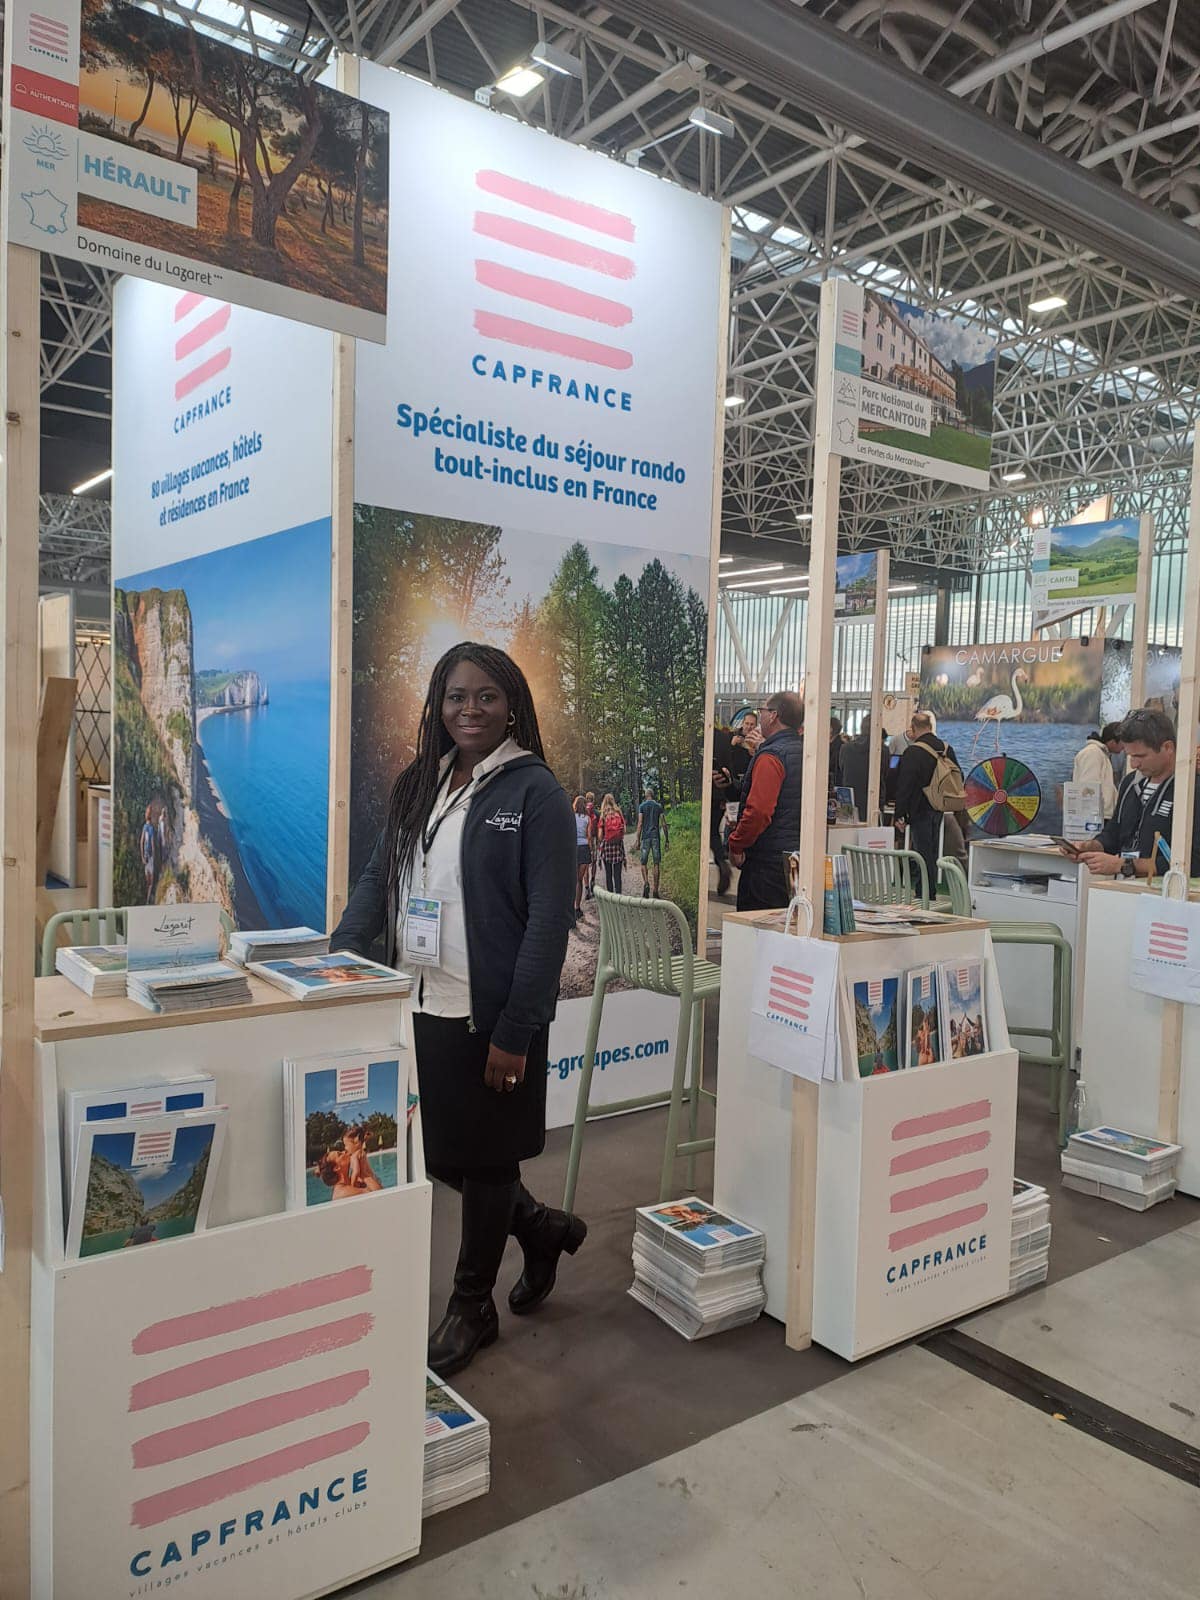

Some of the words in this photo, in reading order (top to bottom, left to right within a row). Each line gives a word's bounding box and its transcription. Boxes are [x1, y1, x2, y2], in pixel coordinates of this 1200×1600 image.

[28, 45, 68, 63] CAPFRANCE
[29, 90, 76, 110] AUTHENTIQUE
[36, 158, 56, 172] MER
[83, 155, 192, 205] HÉRAULT
[77, 235, 142, 267] Domaine
[144, 254, 162, 271] du
[472, 354, 632, 412] CAPFRANCE
[861, 386, 879, 401] Parc
[880, 391, 913, 411] National
[914, 402, 924, 414] du
[174, 386, 231, 434] CAPFRANCE
[861, 402, 927, 431] MERCANTOUR
[396, 402, 527, 453] Spécialiste
[532, 434, 559, 460] du
[564, 439, 627, 473] séjour
[631, 458, 686, 484] rando
[857, 444, 867, 455] Les
[867, 446, 885, 460] Portes
[886, 451, 893, 461] du
[151, 482, 160, 499] 80
[161, 468, 190, 496] villages
[191, 449, 231, 481] vacances,
[232, 431, 262, 462] hôtels
[434, 447, 558, 494] tout-inclus
[563, 479, 587, 498] en
[593, 480, 657, 511] France
[160, 508, 167, 527] et
[167, 493, 206, 524] résidences
[208, 491, 218, 508] en
[220, 476, 250, 504] France
[1050, 576, 1076, 584] CANTAL
[955, 646, 1061, 665] CAMARGUE
[766, 1011, 808, 1033] CAPFRANCE
[886, 1235, 987, 1283] CAPFRANCE
[130, 1468, 368, 1577] CAPFRANCE
[129, 1570, 189, 1598] villages
[197, 1543, 260, 1572] vacances
[267, 1533, 280, 1545] et
[287, 1515, 328, 1537] hôtels
[335, 1500, 368, 1519] clubs
